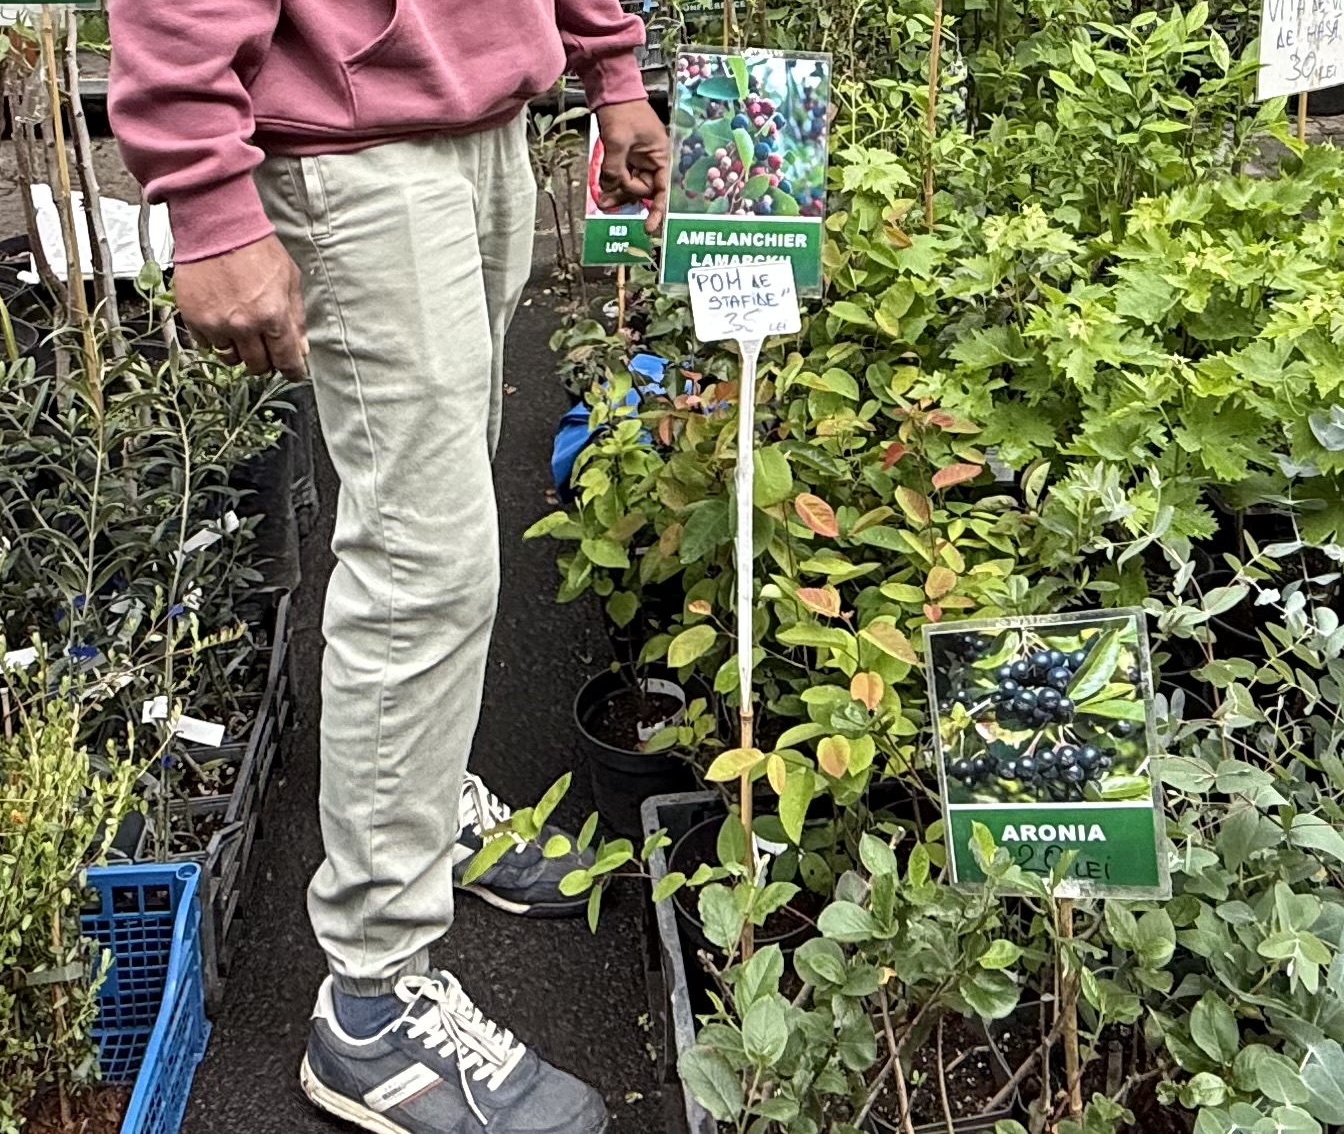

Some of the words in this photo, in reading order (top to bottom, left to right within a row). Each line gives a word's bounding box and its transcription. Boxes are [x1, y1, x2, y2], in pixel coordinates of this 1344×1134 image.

[1285, 51, 1317, 82] 30
[676, 230, 808, 248] AMELANCHIER
[1001, 824, 1106, 842] ARONIA
